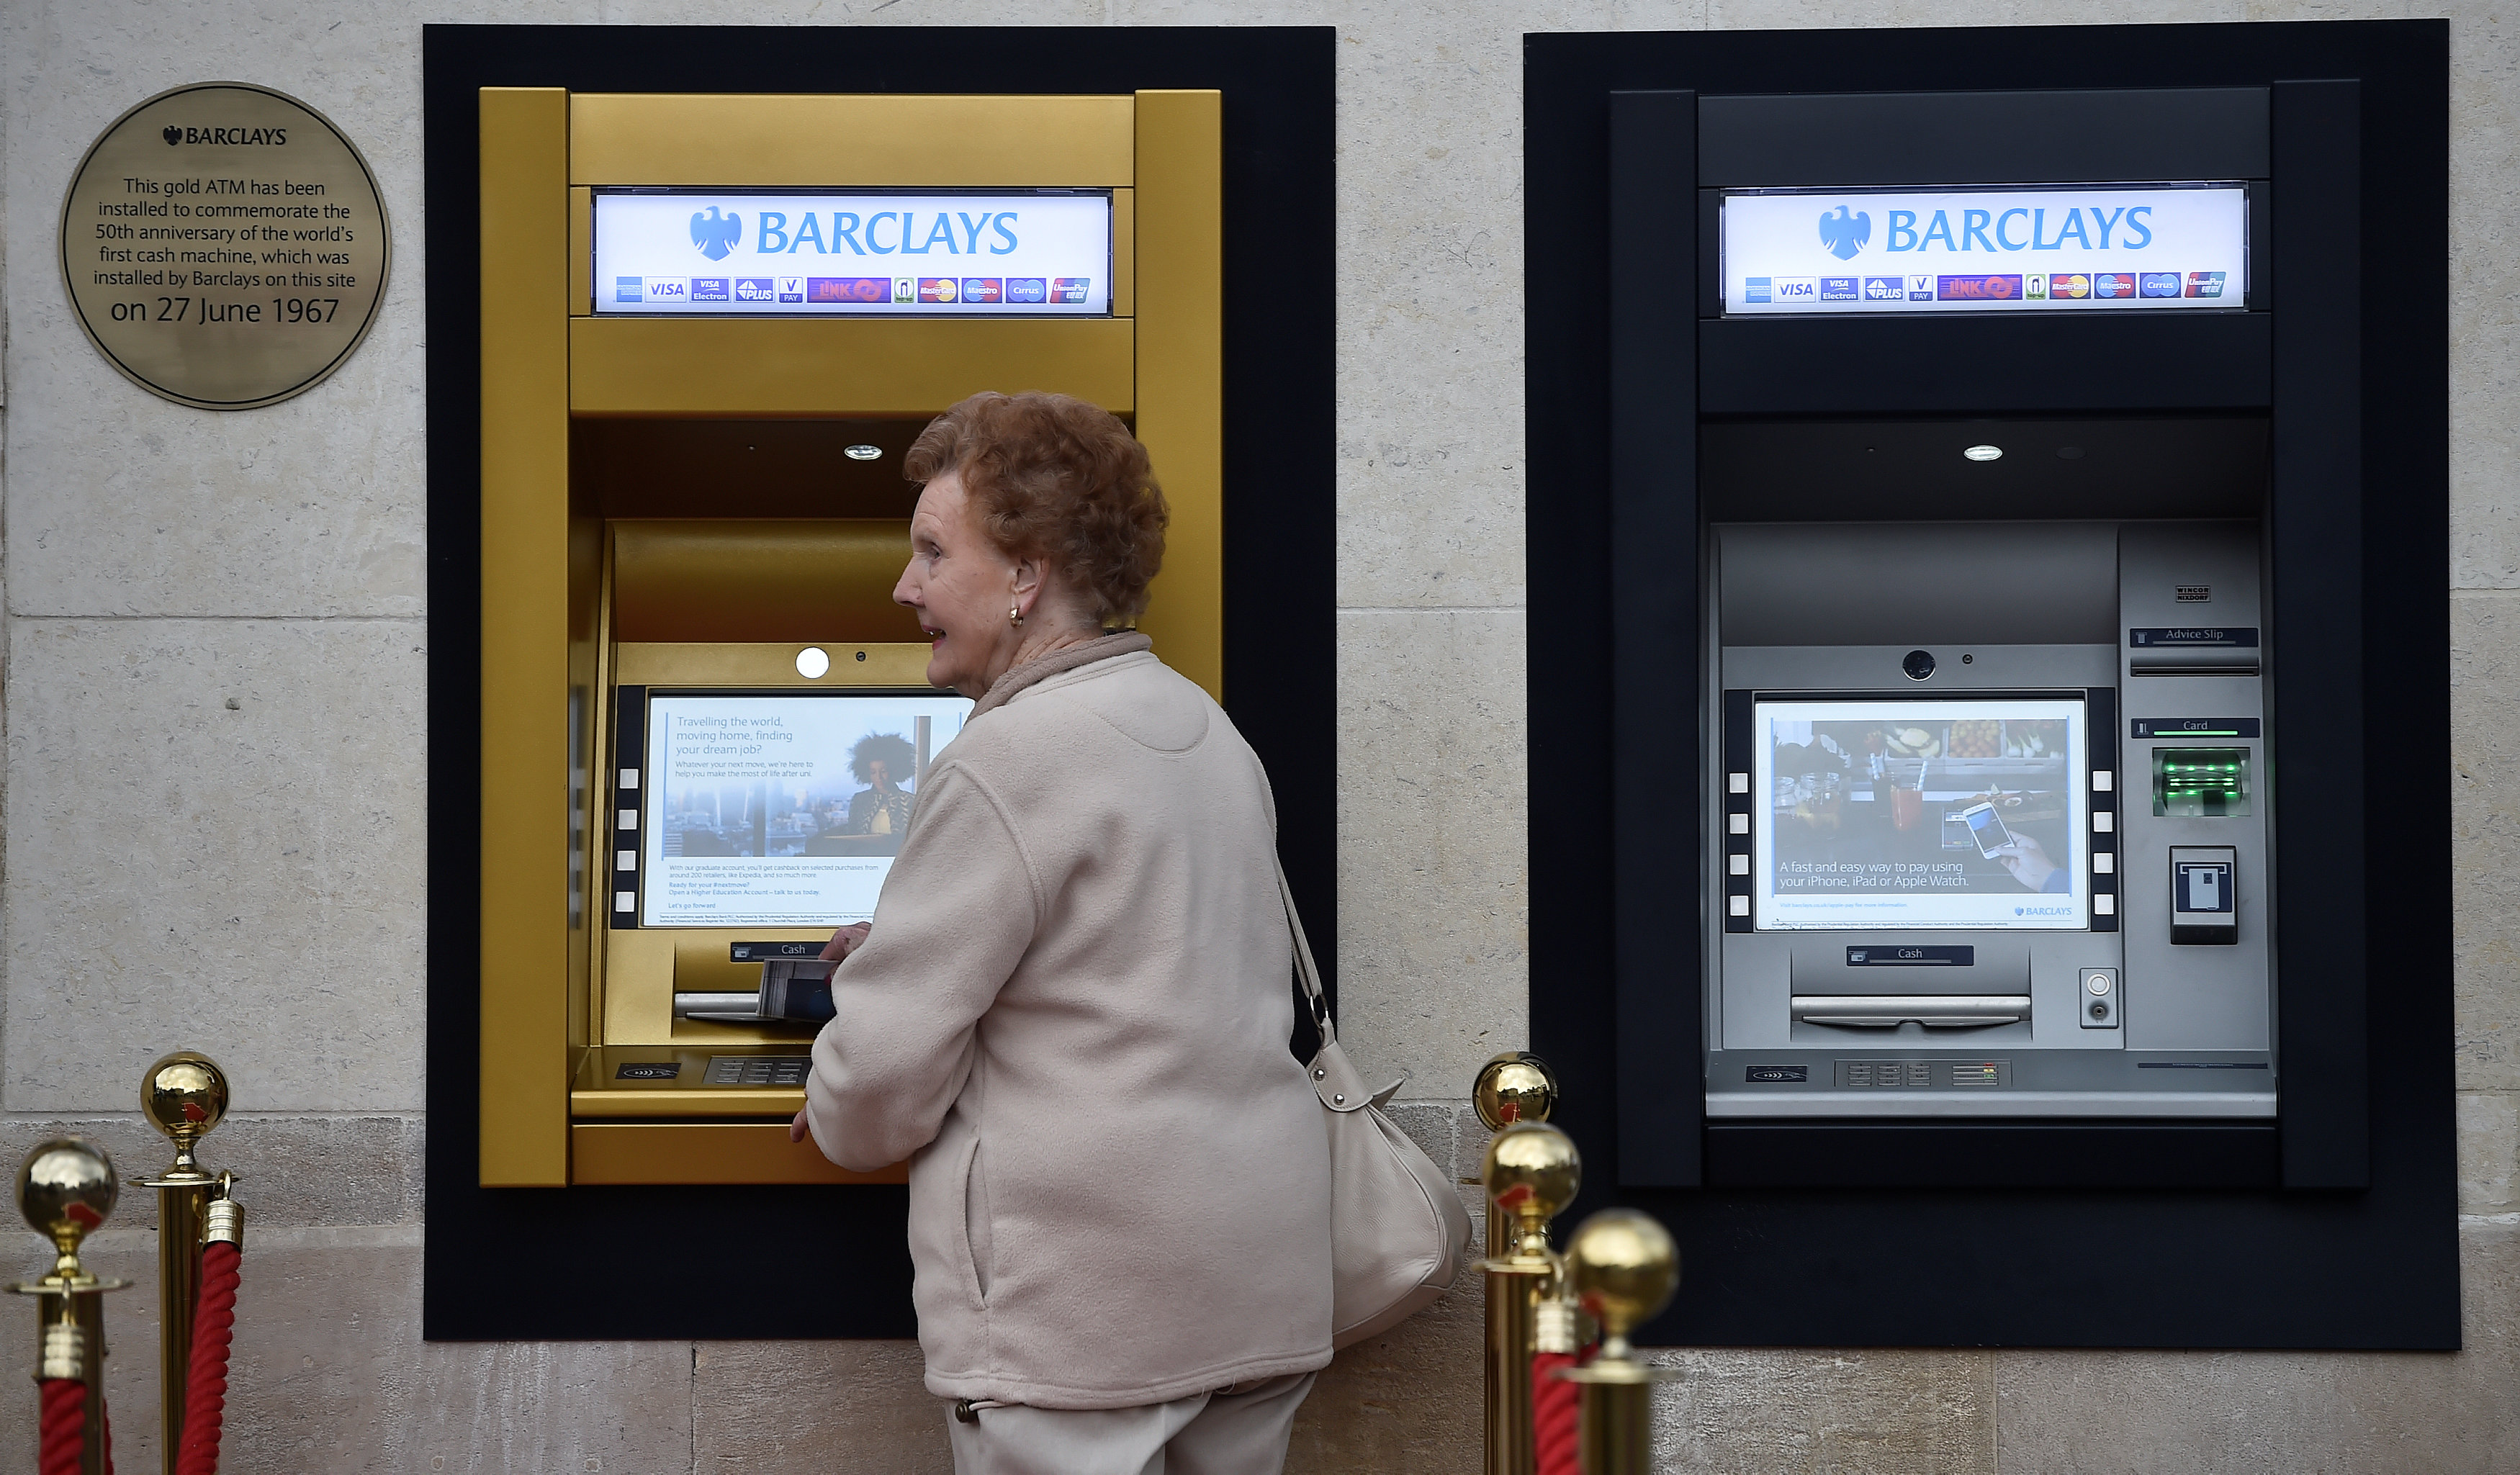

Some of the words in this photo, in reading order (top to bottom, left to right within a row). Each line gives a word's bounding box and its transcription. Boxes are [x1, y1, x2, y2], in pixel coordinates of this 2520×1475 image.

[186, 127, 287, 145] BARCLAYS
[123, 178, 158, 194] This
[164, 179, 200, 198] gold
[205, 179, 245, 194] ATM
[251, 179, 279, 195] has
[285, 179, 325, 196] been
[99, 201, 168, 217] installed
[173, 203, 190, 217] to
[195, 204, 318, 219] commemorate
[323, 203, 350, 219] the
[96, 223, 134, 239] 50th
[139, 225, 235, 244] anniversary
[240, 225, 258, 240] of
[261, 225, 289, 241] the
[293, 226, 354, 242] world’s
[757, 211, 1018, 256] BARCLAYS
[1886, 206, 2153, 253] BARCLAYS
[99, 245, 132, 262] first
[137, 247, 175, 262] cash
[181, 248, 256, 266] machine,
[261, 248, 311, 263] which
[317, 253, 349, 264] was
[94, 269, 163, 285] installed
[168, 270, 188, 289] by
[193, 271, 260, 289] Barclays
[266, 275, 287, 287] on
[291, 271, 322, 287] this
[327, 273, 356, 287] site
[786, 279, 797, 291] V
[1916, 278, 1927, 289] V
[2189, 278, 2223, 288] UnionPay
[650, 284, 684, 295] VISA
[819, 281, 851, 299] LINK
[1053, 284, 1088, 294] UnionPay
[1779, 284, 1814, 295] VISA
[1876, 289, 1902, 299] PLUS
[1949, 279, 1981, 297] LINK
[744, 291, 772, 299] PLUS
[111, 303, 145, 321] on
[157, 297, 190, 321] 27
[199, 298, 261, 325] June
[273, 298, 339, 323] 1967
[2166, 629, 2201, 639] Advice
[2204, 629, 2223, 640] Slip
[677, 716, 727, 729] Travelling
[731, 716, 747, 726] the
[750, 716, 783, 727] world,
[2184, 721, 2208, 730] Card
[677, 731, 716, 743] moving
[719, 731, 752, 741] home,
[756, 730, 793, 743] finding
[676, 746, 700, 757] your
[703, 744, 737, 754] dream
[739, 744, 762, 757] job?
[1780, 862, 1788, 872] A
[1791, 861, 1813, 872] fast
[1815, 861, 1837, 872] and
[1840, 864, 1866, 875] easy
[1868, 864, 1891, 875] way
[1894, 862, 1907, 872] to
[1909, 864, 1930, 875] pay
[1932, 862, 1963, 875] using
[1780, 878, 1805, 889] your
[1808, 875, 1850, 887] iPhone,
[1853, 874, 1876, 886] iPad
[1894, 875, 1927, 888] Apple
[1929, 875, 1969, 886] Watch.
[2026, 907, 2072, 916] BARCLAYS
[781, 944, 806, 954] Cash
[1898, 948, 1922, 958] Cash
